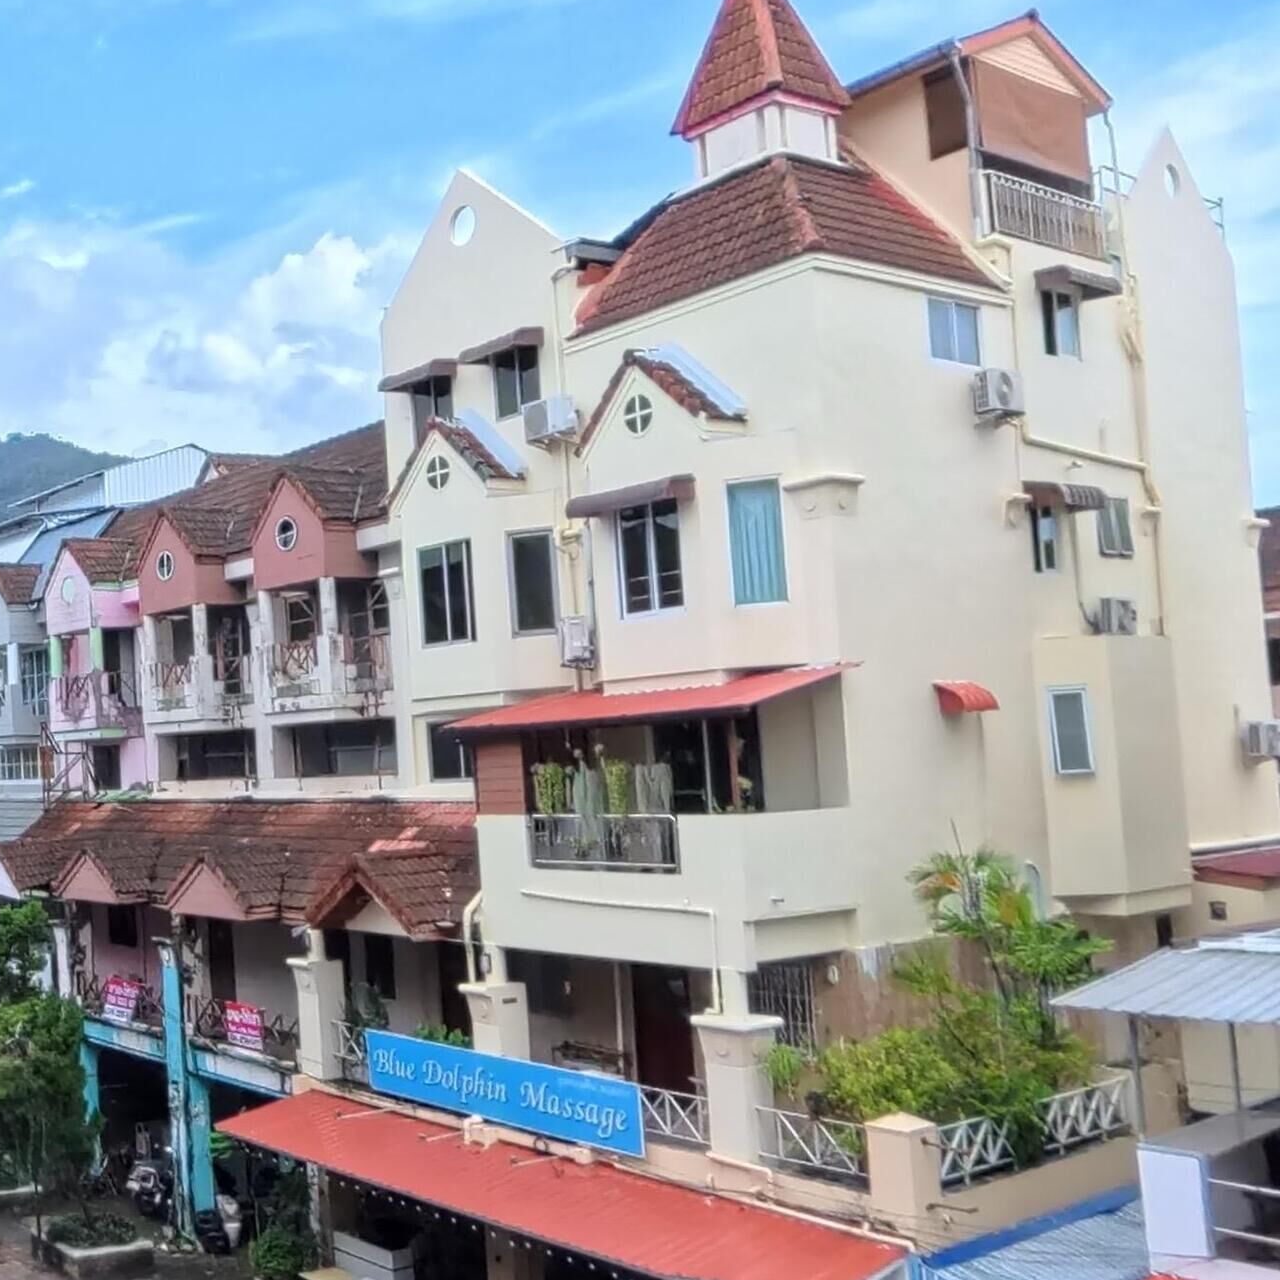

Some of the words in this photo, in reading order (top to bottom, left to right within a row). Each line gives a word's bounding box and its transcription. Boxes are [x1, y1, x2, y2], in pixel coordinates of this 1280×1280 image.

[374, 1048, 416, 1080] Blue
[423, 1059, 507, 1104] Dolphin
[520, 1082, 627, 1137] Massage
